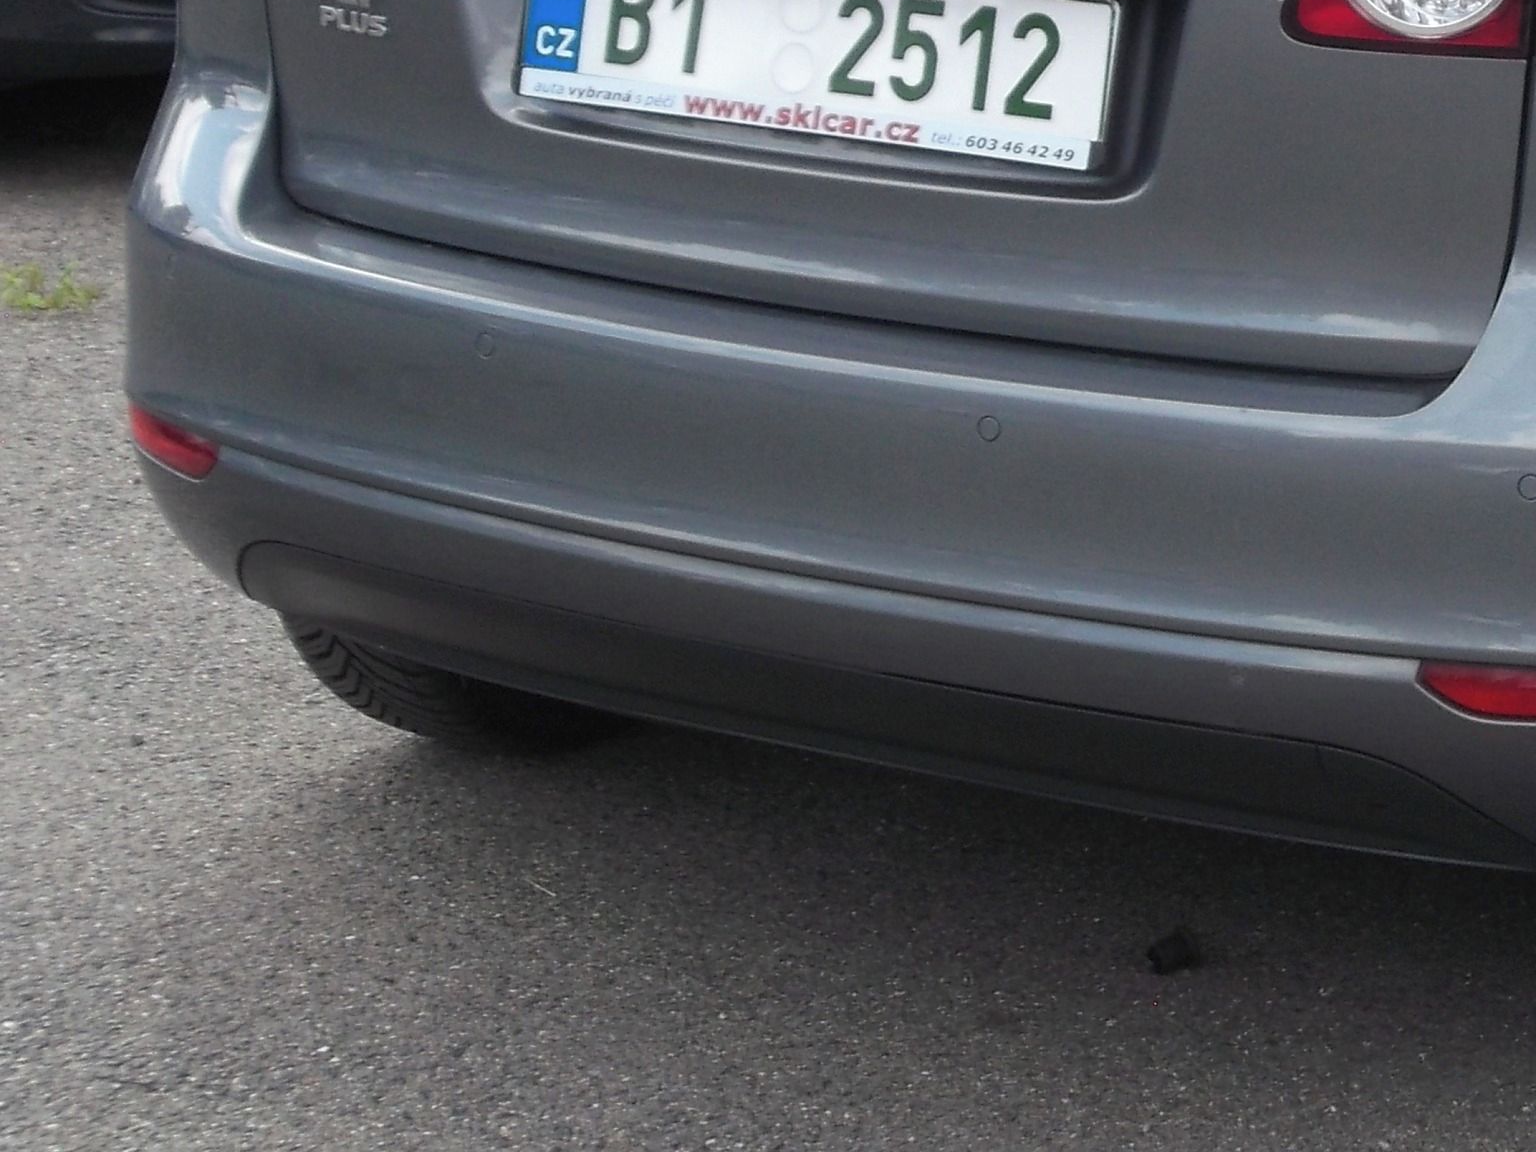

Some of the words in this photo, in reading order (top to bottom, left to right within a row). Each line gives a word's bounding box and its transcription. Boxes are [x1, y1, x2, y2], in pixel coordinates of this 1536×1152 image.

[319, 4, 388, 37] PLUS
[535, 25, 577, 58] CZ
[568, 83, 633, 103] vybraná
[965, 134, 999, 152] 603
